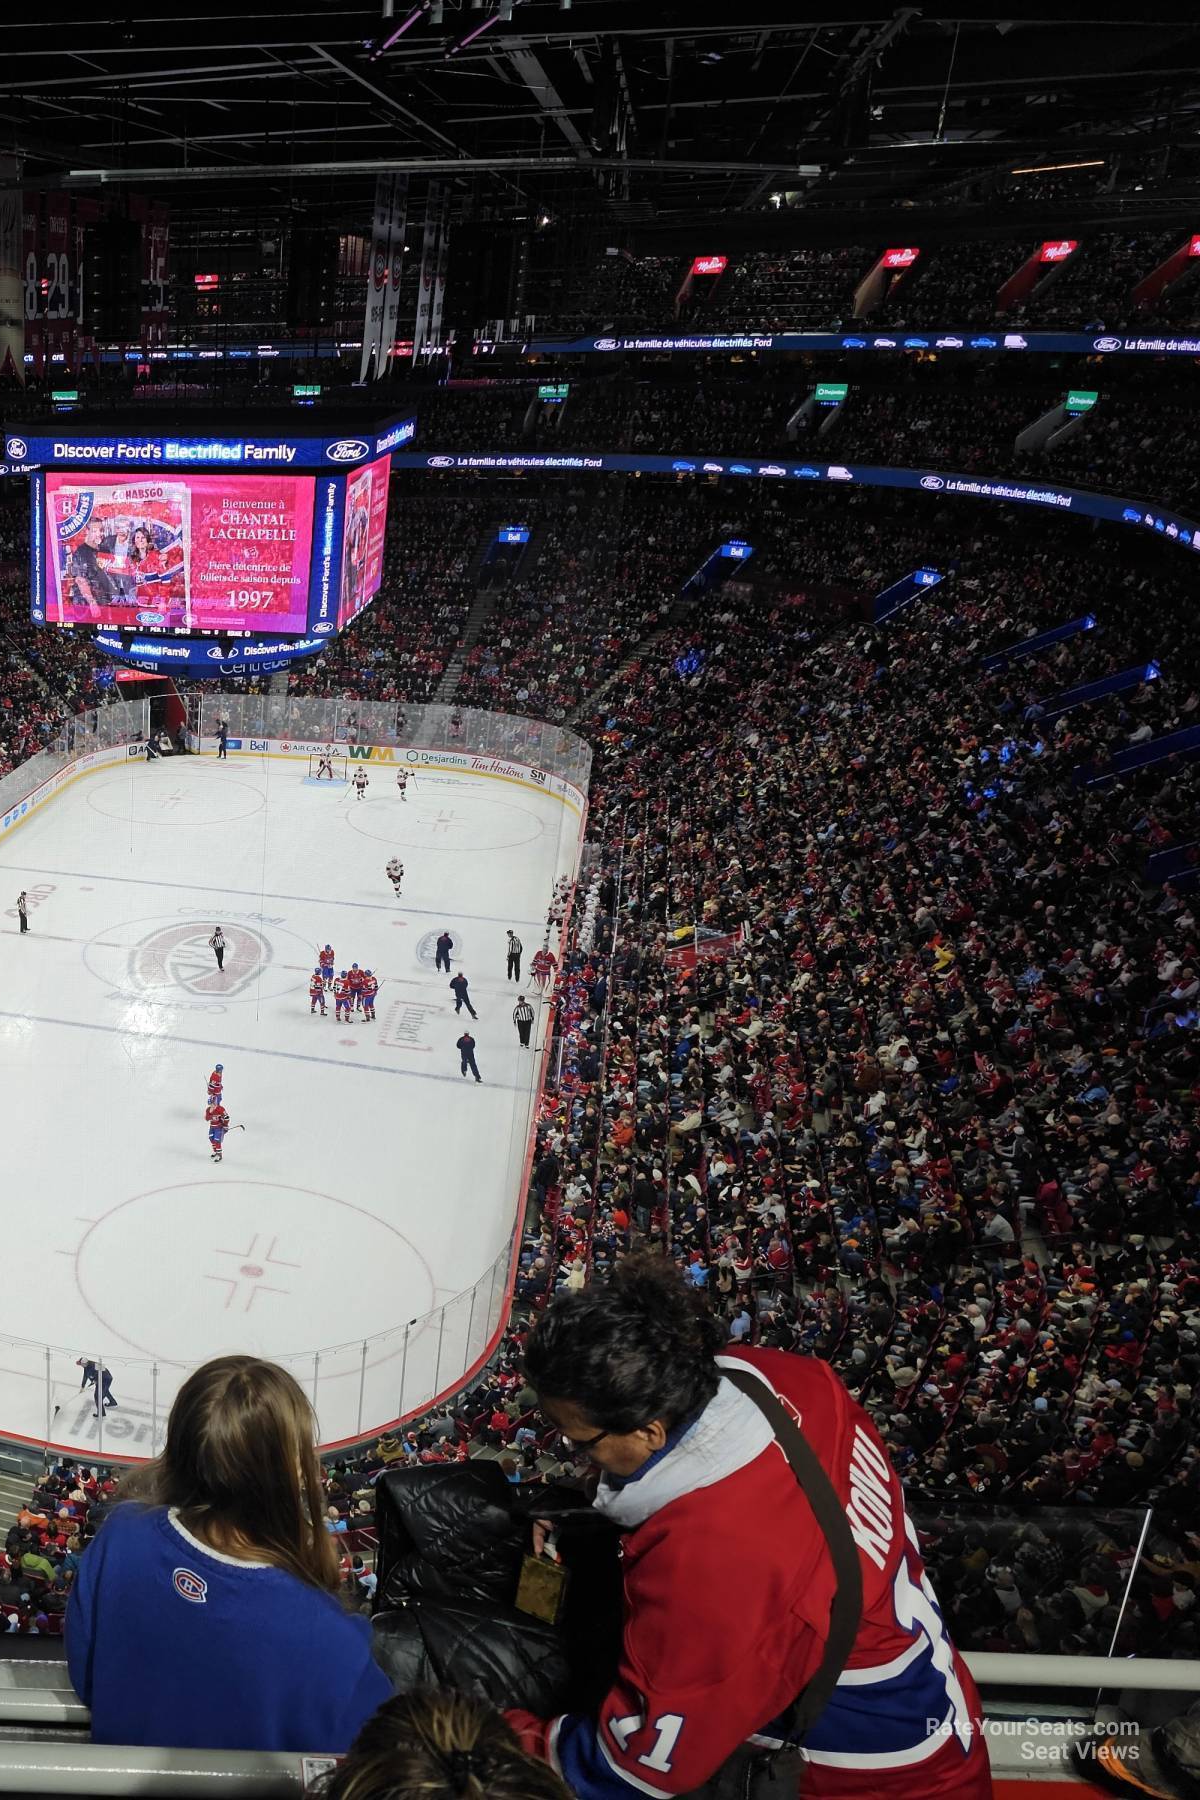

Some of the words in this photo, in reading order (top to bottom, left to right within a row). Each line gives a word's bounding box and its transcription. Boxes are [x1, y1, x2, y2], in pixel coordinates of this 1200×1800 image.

[635, 339, 662, 348] famille
[663, 339, 674, 348] de
[674, 339, 711, 348] véhicules
[712, 339, 752, 347] électrifiés
[754, 338, 772, 347] Ford
[1125, 340, 1135, 349] La
[1137, 339, 1165, 350] famille
[1167, 340, 1177, 350] de
[54, 443, 115, 458] Discover
[117, 443, 162, 458] Ford's
[165, 443, 241, 459] Electrified
[244, 445, 296, 462] Family
[458, 457, 468, 465] La
[468, 457, 496, 466] famille
[497, 457, 507, 466] de
[507, 457, 544, 466] véhicules
[545, 457, 583, 466] électrifiés
[583, 458, 602, 467] Ford
[326, 483, 336, 511] Family
[947, 480, 956, 489] La
[956, 480, 980, 492] famille
[981, 482, 991, 494] de
[991, 485, 1026, 499] véhicules
[1026, 489, 1057, 503] électrifiés
[1056, 495, 1072, 507] Ford
[222, 499, 274, 509] Bienvenue
[220, 513, 287, 526] CHANTAL
[209, 527, 296, 541] LACHAPELLE
[323, 513, 334, 555] Electrified
[279, 563, 291, 572] de
[322, 556, 331, 580] Ford's
[200, 573, 227, 582] billets
[240, 575, 269, 584] saison
[270, 575, 301, 586] depuis
[226, 590, 274, 609] 1997
[320, 581, 329, 617] Discover
[163, 646, 190, 658] Family
[250, 740, 268, 751] Bell
[349, 746, 395, 761] WM
[421, 753, 467, 766] Desjardins
[471, 757, 484, 771] Tim
[490, 760, 524, 779] Hortons
[530, 769, 547, 781] SN
[845, 1425, 892, 1571] KOIVU
